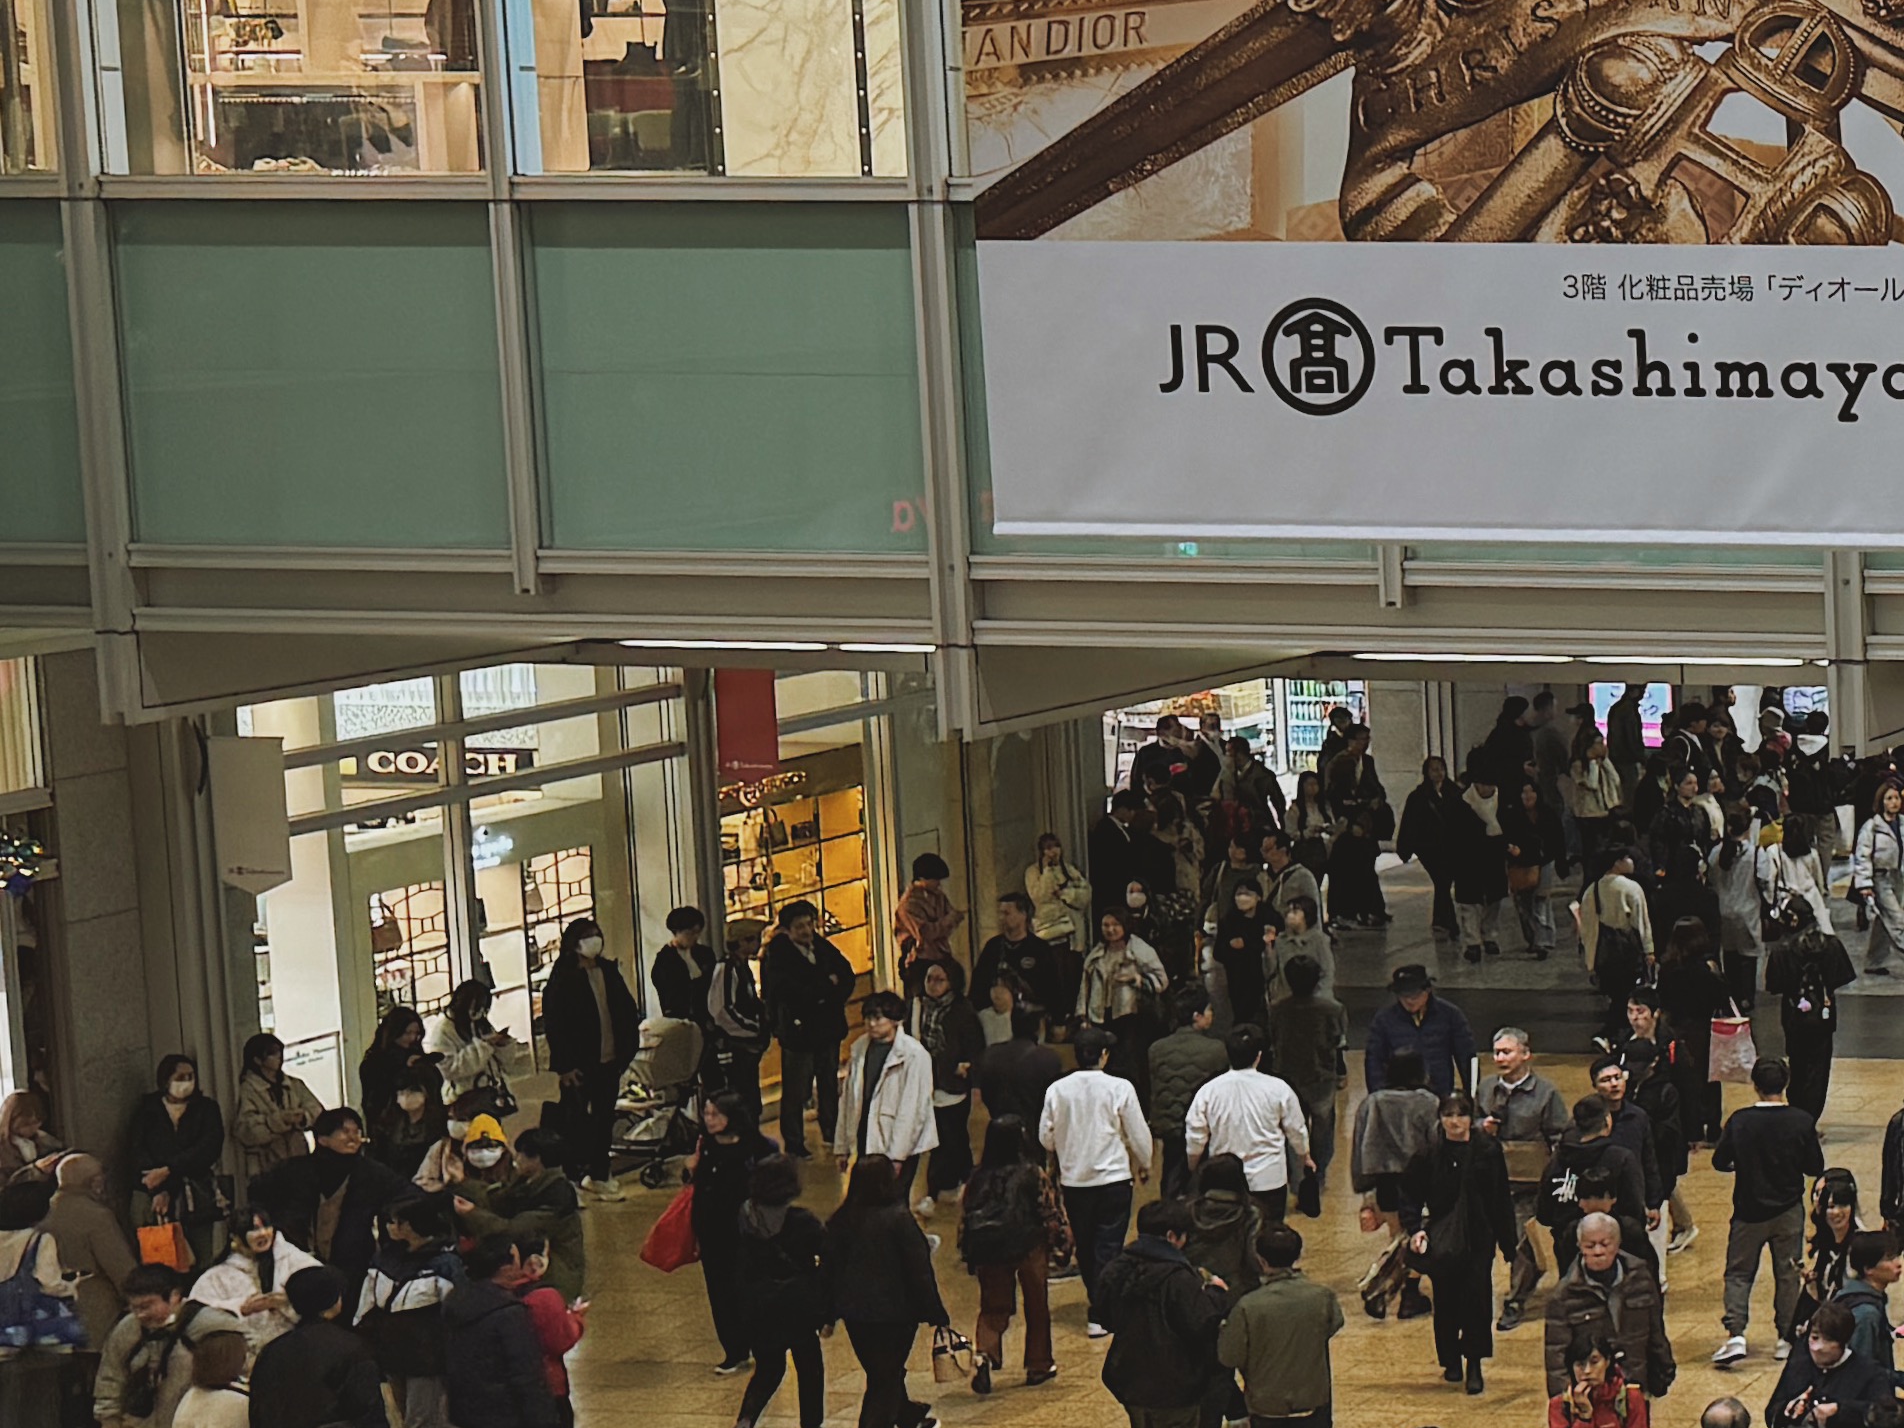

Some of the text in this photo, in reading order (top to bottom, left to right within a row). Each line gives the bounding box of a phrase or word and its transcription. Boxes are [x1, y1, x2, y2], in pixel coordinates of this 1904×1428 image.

[1046, 11, 1147, 56] DIOR
[1562, 273, 1607, 301] 3階
[1159, 324, 1256, 395] JR
